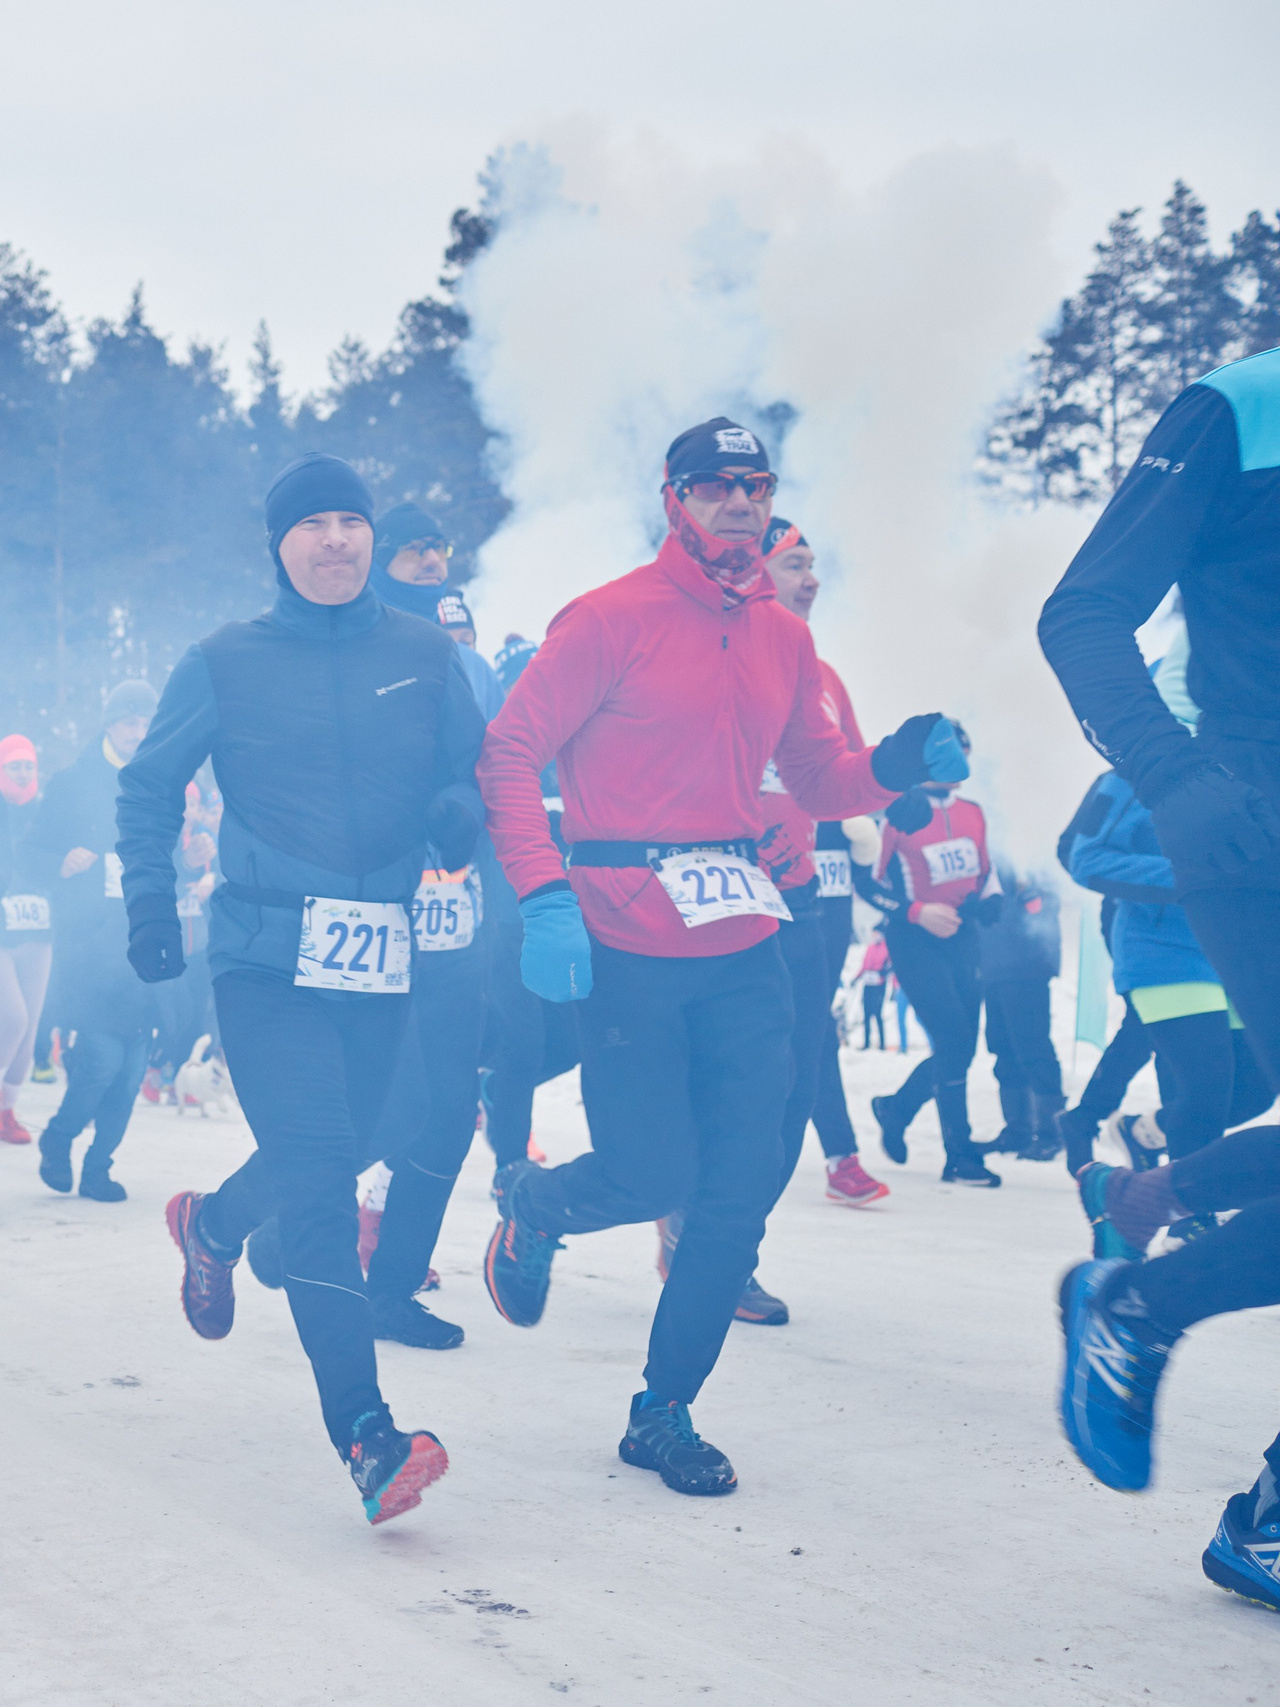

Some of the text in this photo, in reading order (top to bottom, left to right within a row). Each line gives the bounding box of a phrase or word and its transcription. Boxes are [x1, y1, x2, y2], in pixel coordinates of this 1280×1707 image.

[1140, 456, 1185, 474] PRO
[940, 849, 965, 873] 115
[681, 866, 756, 906] 227
[14, 903, 40, 922] 148
[412, 899, 458, 936] 205
[322, 921, 389, 973] 221
